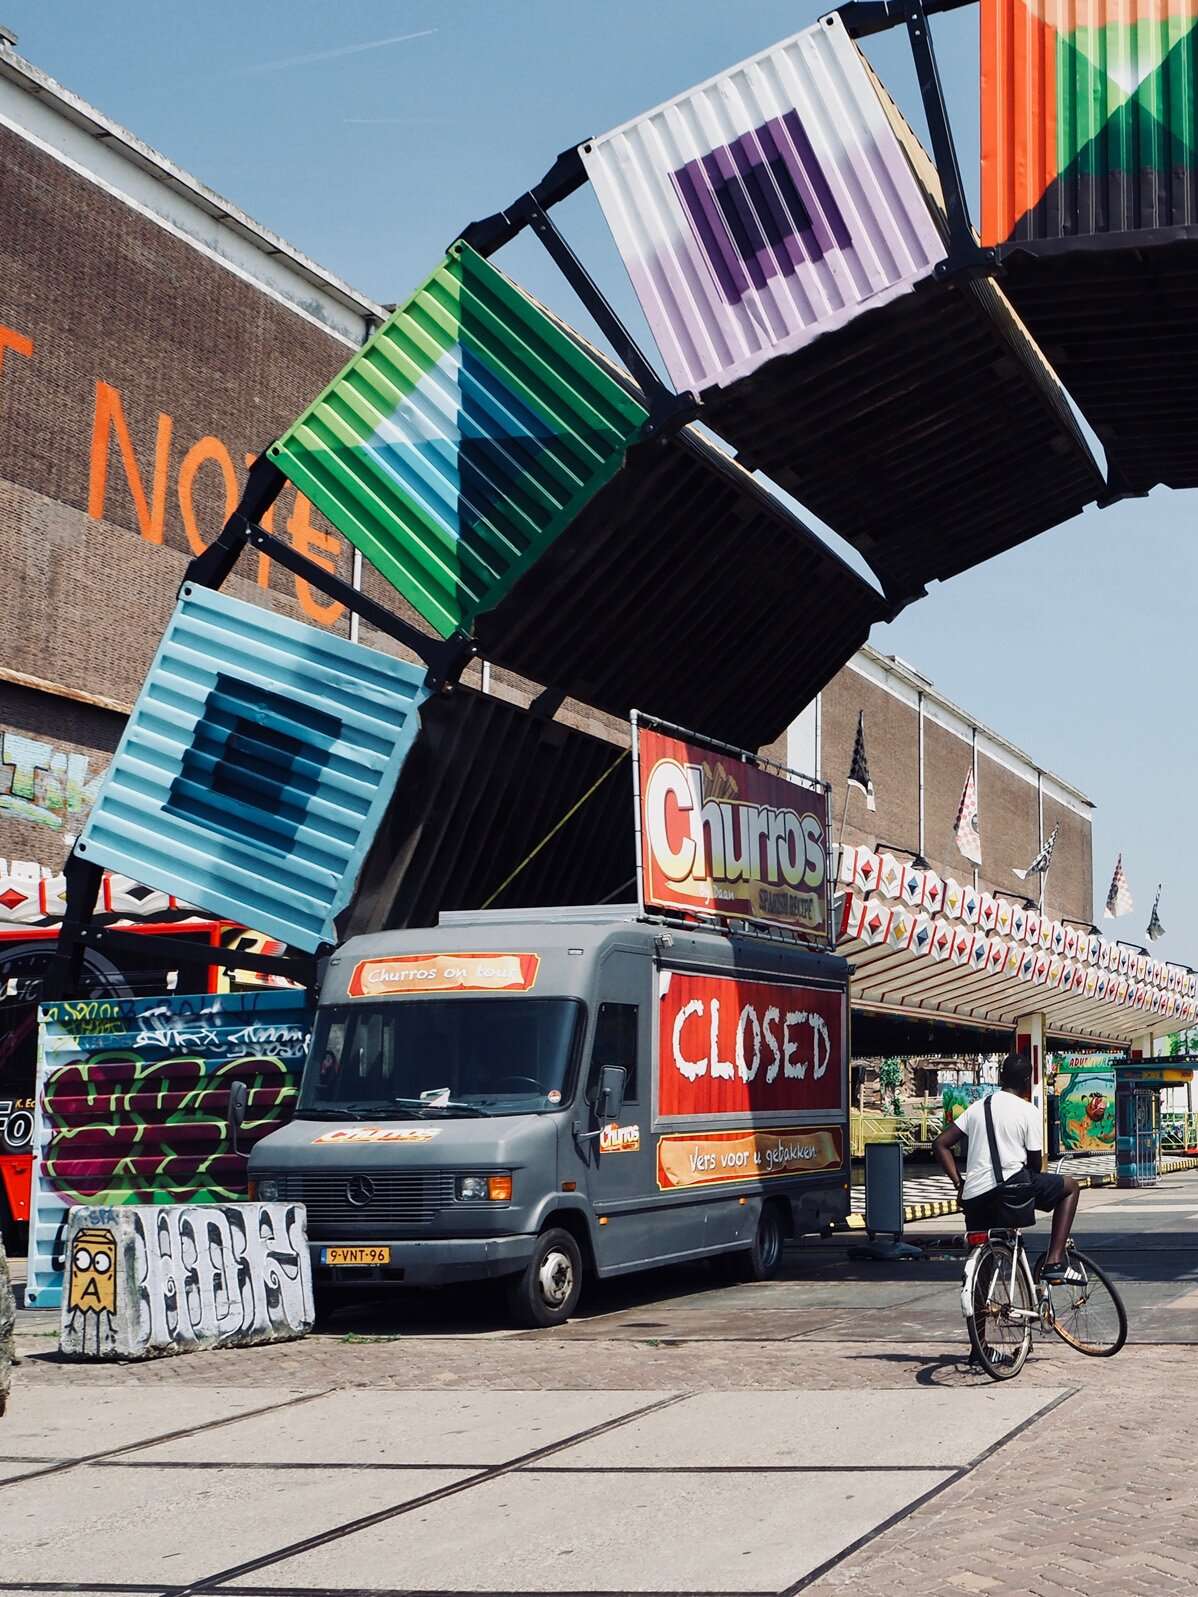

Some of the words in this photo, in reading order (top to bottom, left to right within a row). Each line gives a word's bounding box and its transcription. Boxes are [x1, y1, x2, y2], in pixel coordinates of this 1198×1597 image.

[647, 759, 825, 887] Churros
[367, 967, 436, 983] Churros
[444, 968, 468, 978] on
[476, 964, 515, 979] tour
[672, 998, 831, 1084] CLOSED
[689, 1146, 715, 1172] Vers
[721, 1151, 749, 1168] voor
[753, 1154, 761, 1165] u
[766, 1138, 816, 1171] gebakken
[329, 1249, 386, 1262] 9-VNT-96
